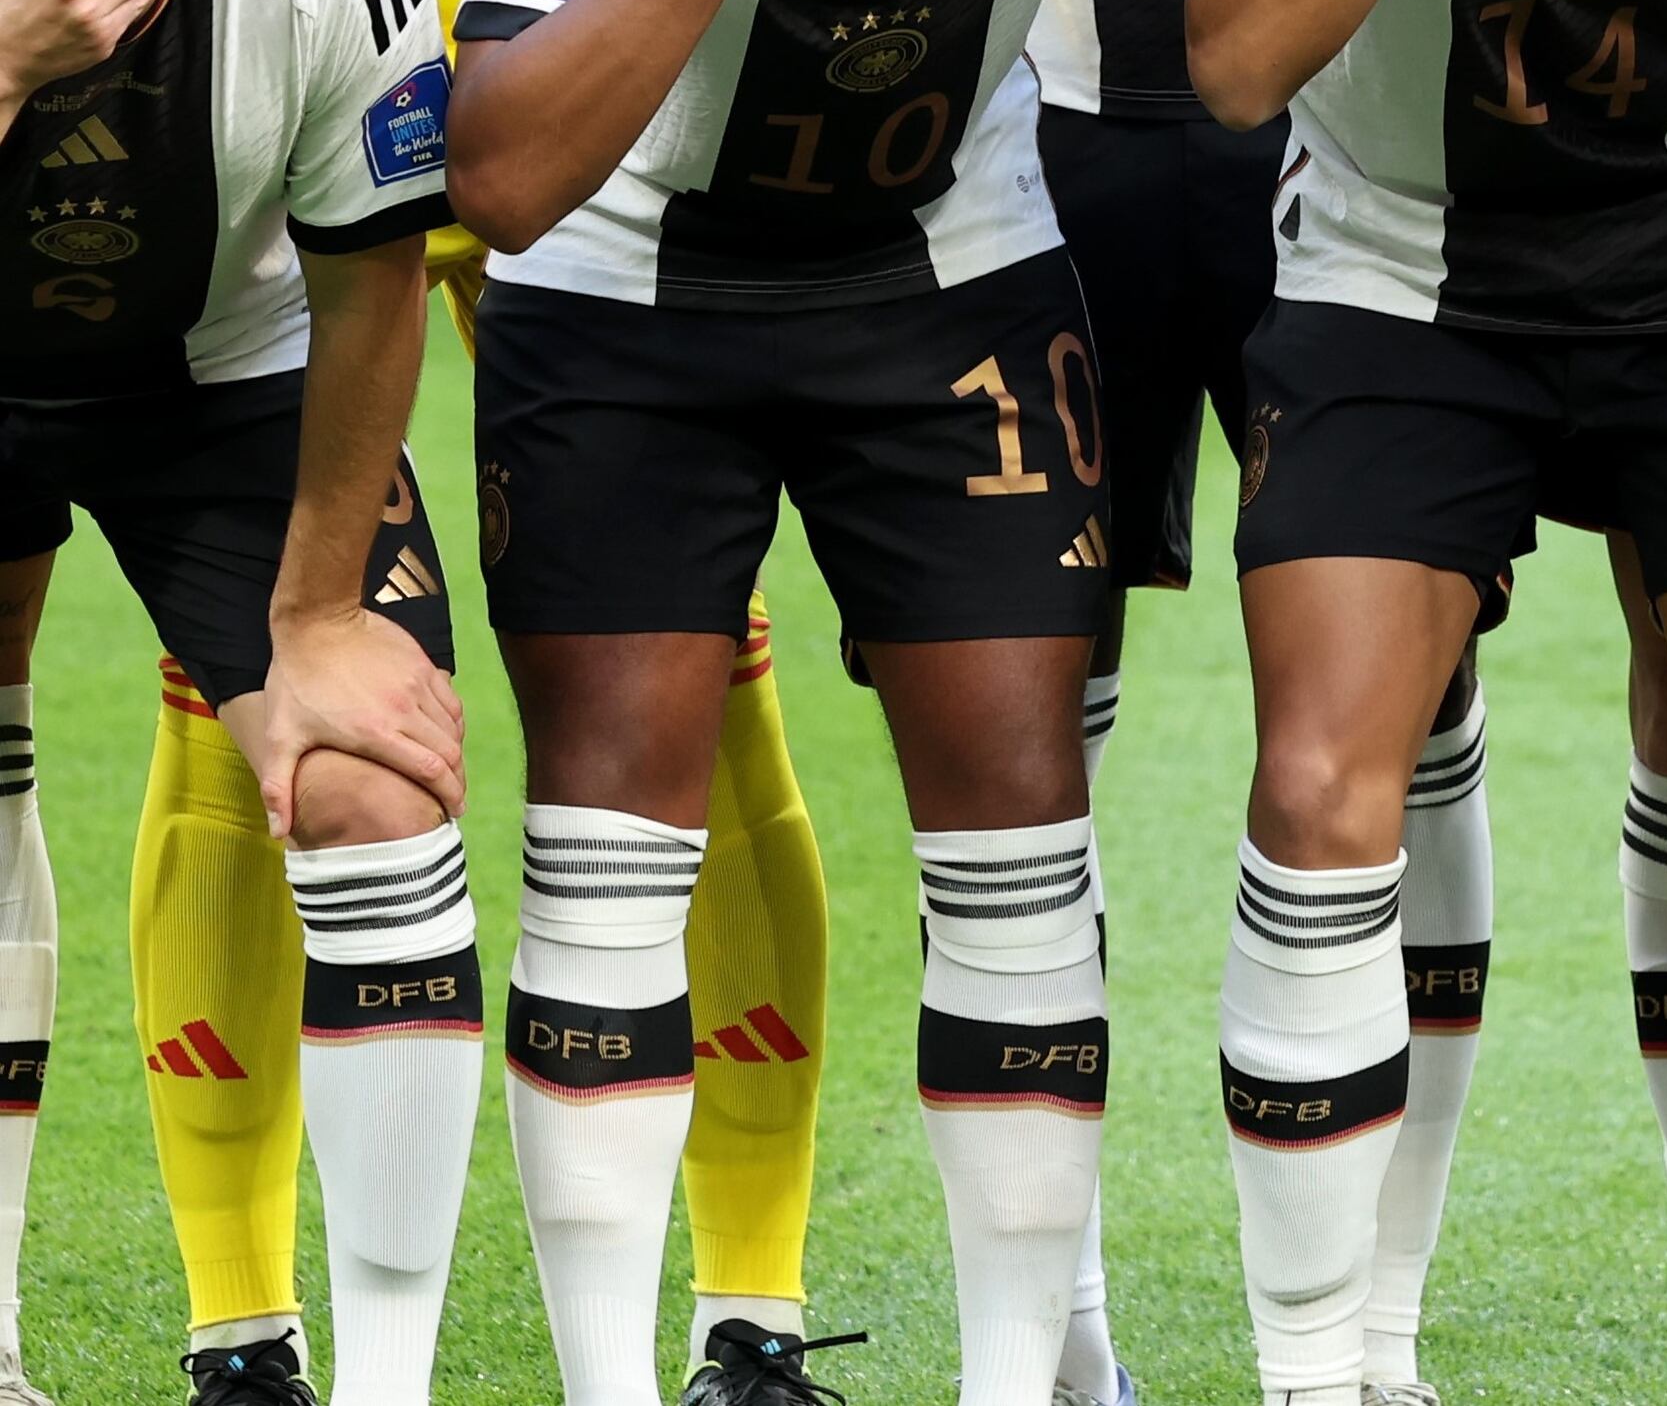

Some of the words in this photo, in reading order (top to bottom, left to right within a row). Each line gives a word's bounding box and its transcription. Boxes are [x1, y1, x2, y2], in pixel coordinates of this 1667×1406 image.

[387, 106, 434, 131] FOOTBALL
[391, 117, 437, 143] UNITES
[392, 142, 412, 157] the
[411, 129, 444, 151] World
[412, 151, 433, 163] FIFA
[750, 91, 949, 194] 10
[950, 331, 1103, 497] 10
[357, 976, 457, 1007] DFB
[528, 1019, 633, 1061] DFB
[0, 1059, 47, 1082] FB
[1000, 1044, 1100, 1074] DFB
[1229, 1086, 1332, 1123] DFB
